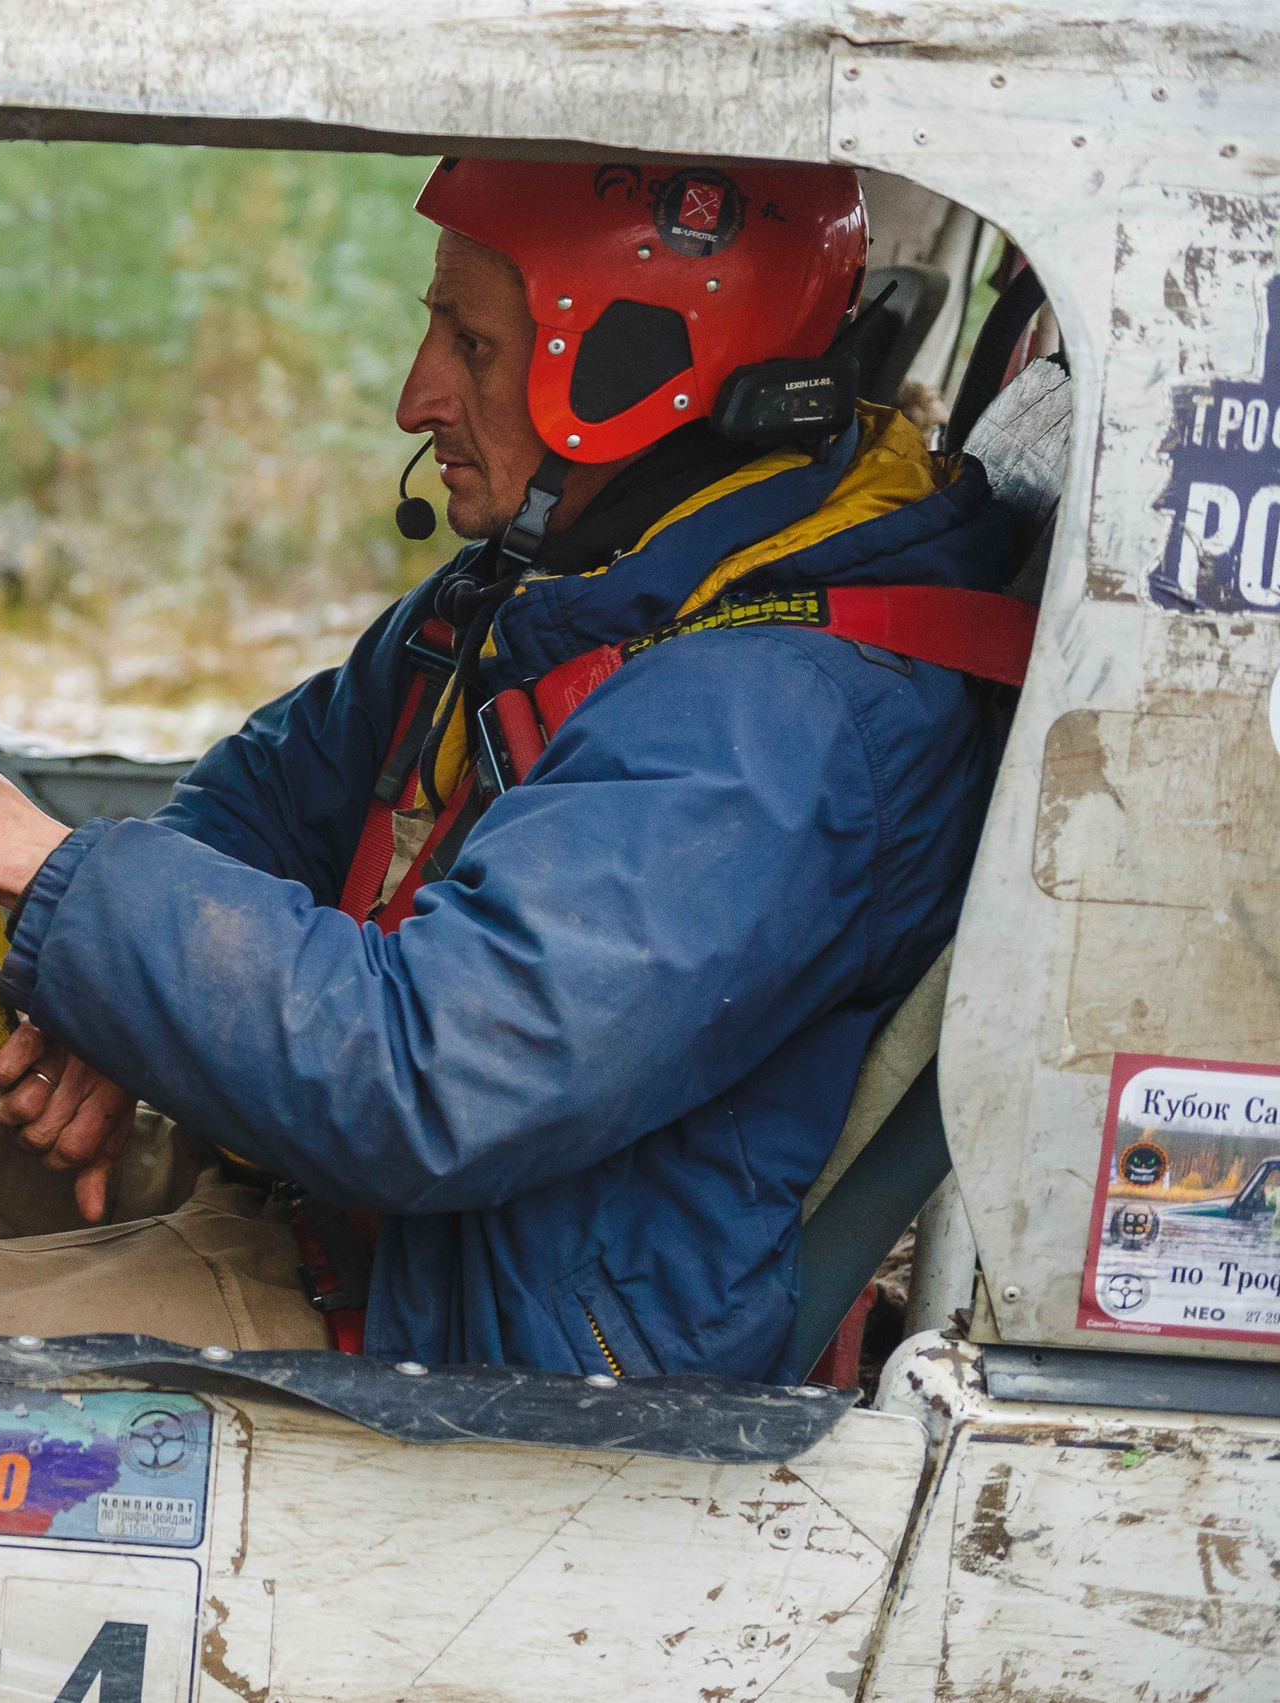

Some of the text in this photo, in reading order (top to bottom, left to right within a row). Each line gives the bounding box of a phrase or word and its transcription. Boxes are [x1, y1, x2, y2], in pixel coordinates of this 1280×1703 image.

[785, 380, 809, 391] LEXIN
[1141, 1088, 1279, 1125] Кубок Са
[1170, 1266, 1204, 1286] по
[1183, 1305, 1226, 1322] NEO
[100, 1497, 194, 1514] чемпионат
